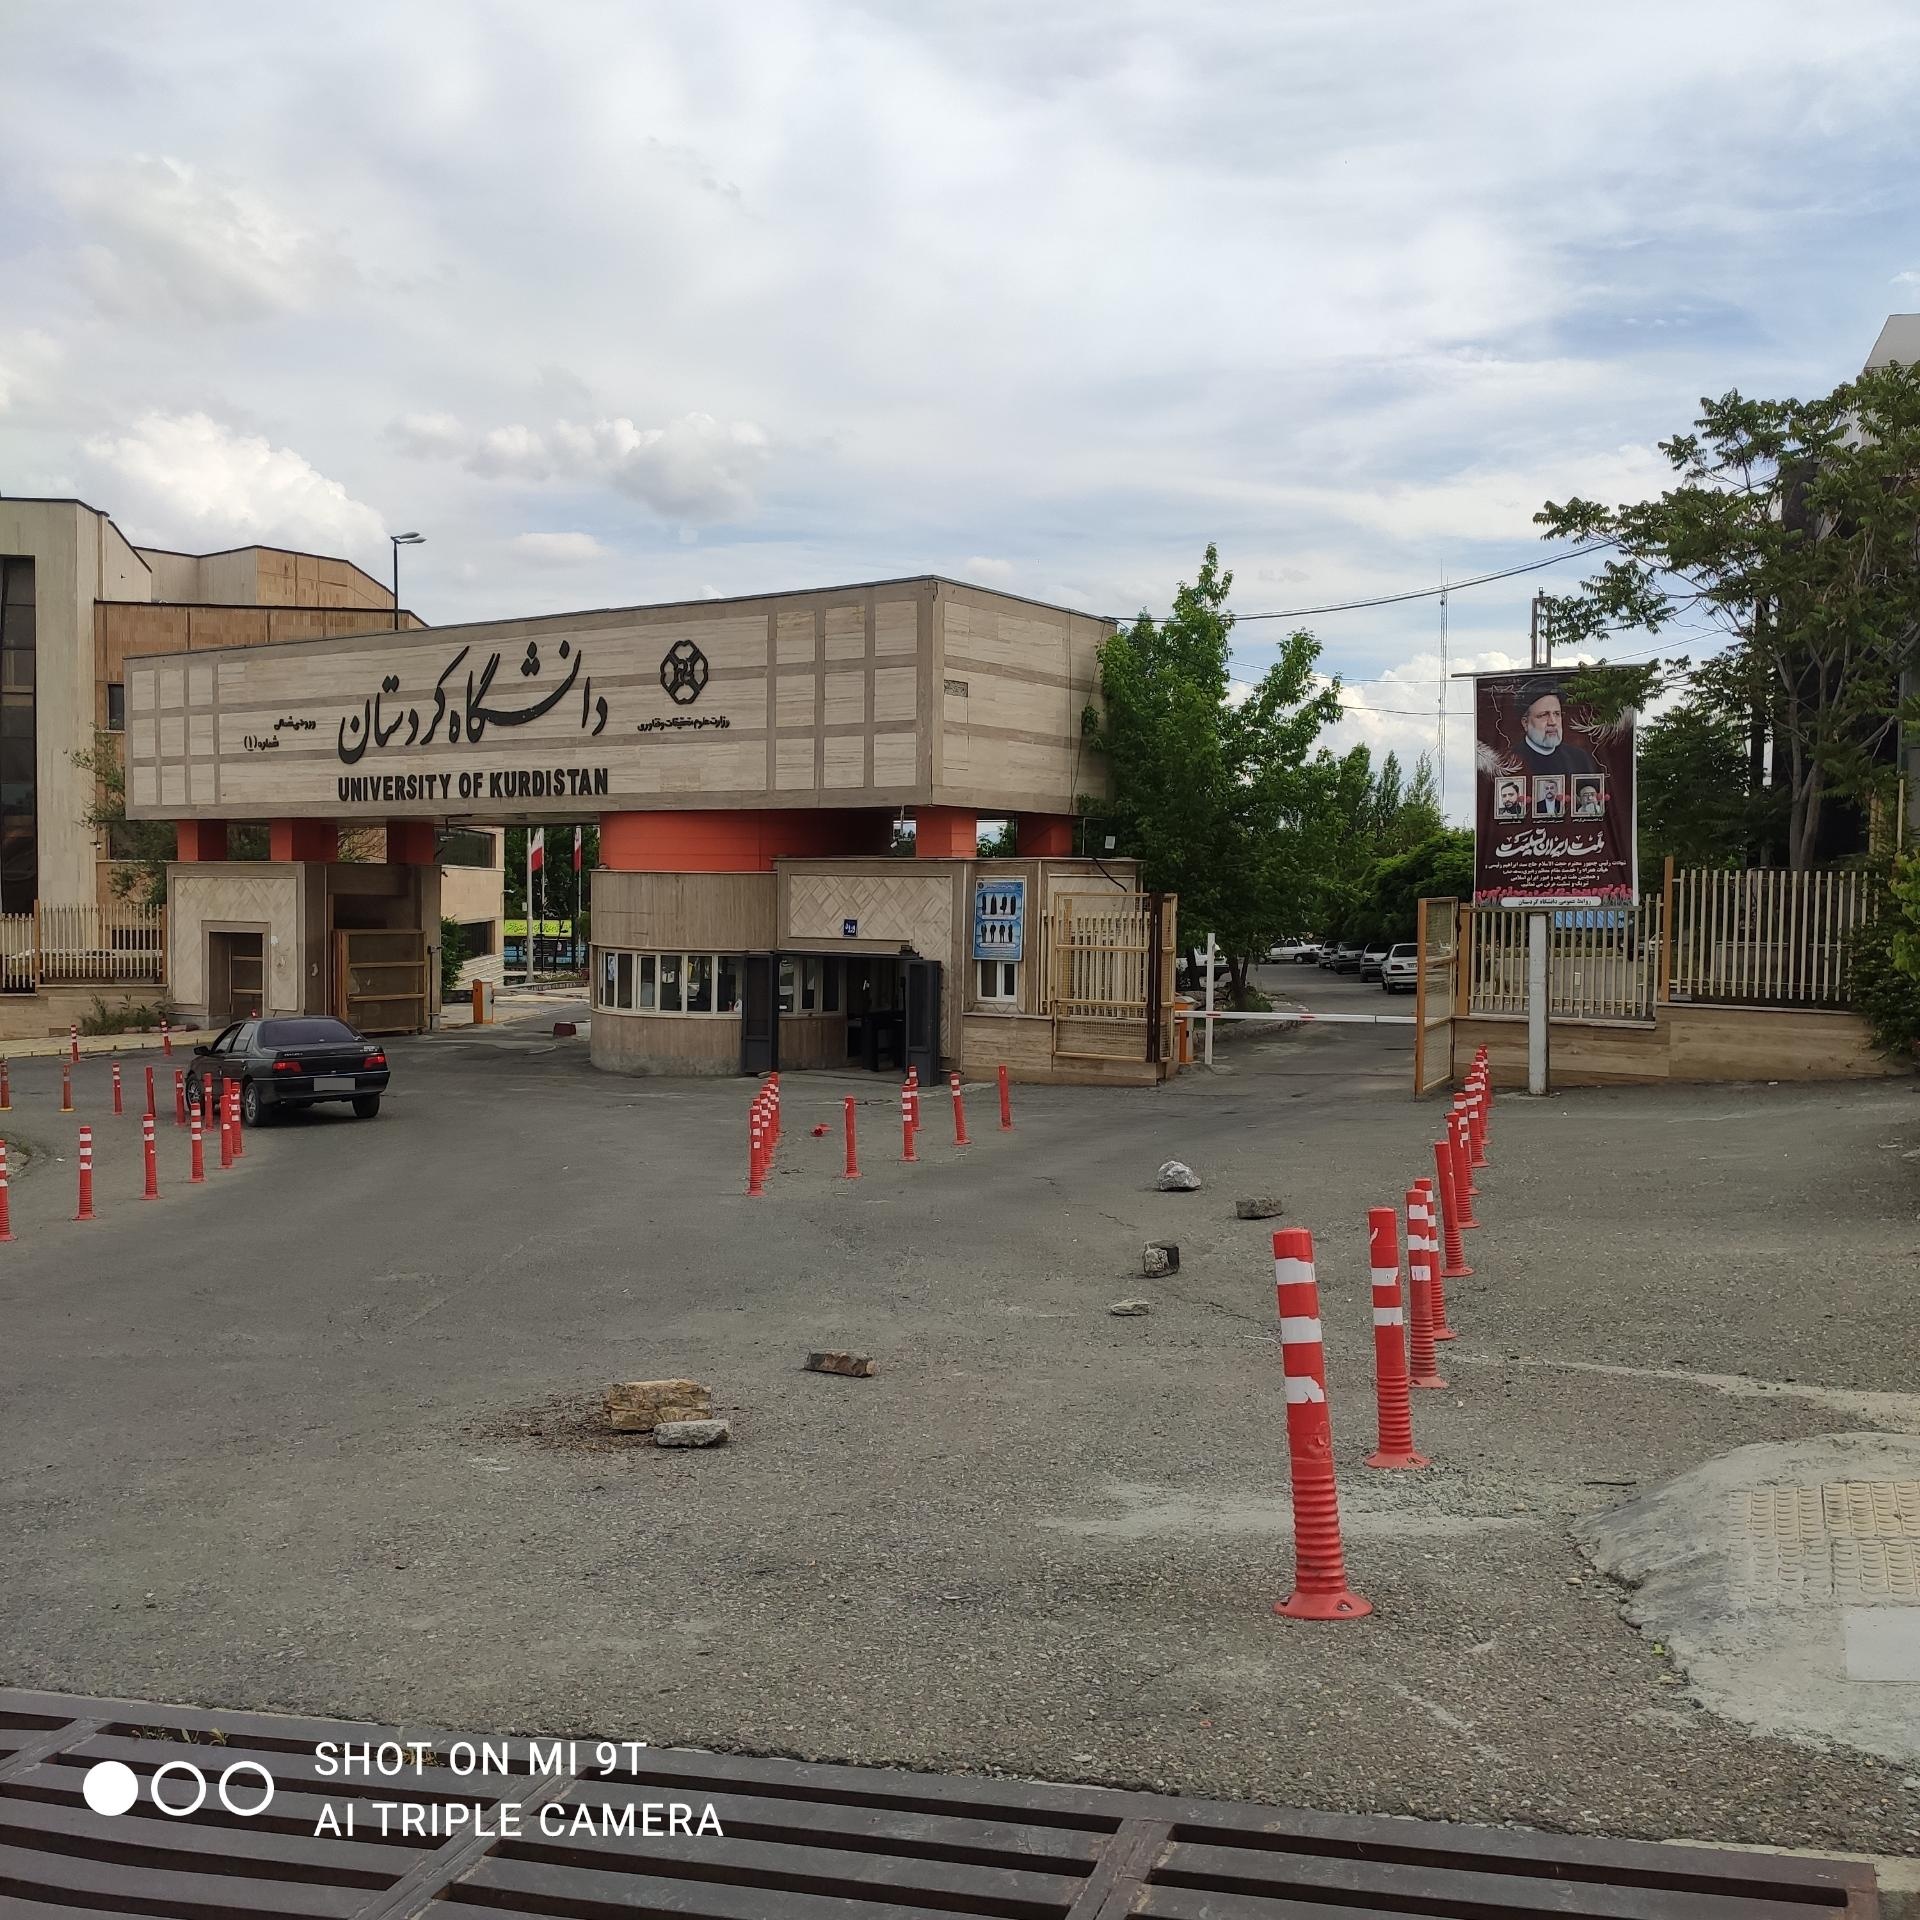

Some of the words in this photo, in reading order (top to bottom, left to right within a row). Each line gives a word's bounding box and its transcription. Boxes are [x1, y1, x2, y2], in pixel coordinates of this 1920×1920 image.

[449, 640, 608, 744] دانشگاه
[338, 645, 469, 764] کردستان
[709, 715, 731, 728] وزارت
[258, 734, 280, 751] شماره
[338, 773, 451, 801] UNIVERSITY
[458, 772, 484, 799] OF
[489, 768, 608, 798] KURDISTAN
[1495, 828, 1547, 857] تسلیت
[1533, 835, 1569, 858] ایران
[1567, 831, 1605, 856] ملت
[1518, 898, 1539, 906] کردستان
[1576, 898, 1592, 906] روابط
